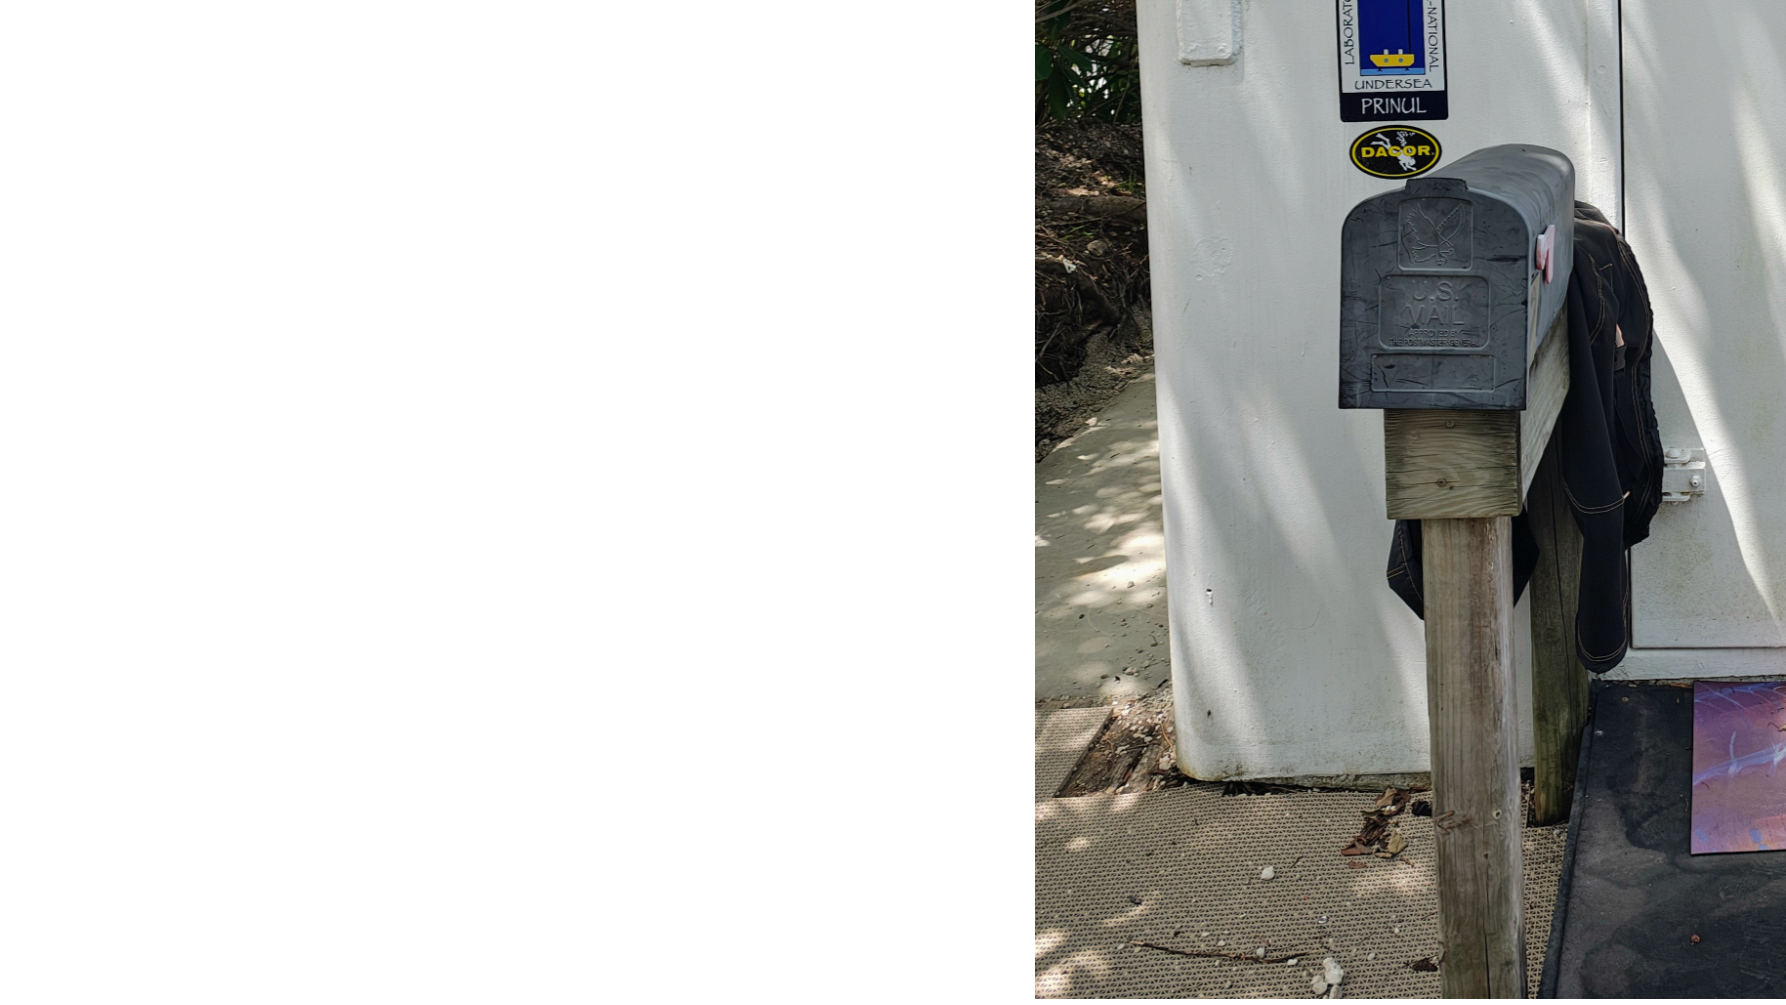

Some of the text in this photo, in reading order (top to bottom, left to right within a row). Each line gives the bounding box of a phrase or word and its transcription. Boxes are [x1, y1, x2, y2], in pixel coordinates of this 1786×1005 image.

[1354, 78, 1433, 91] UNDERSEA
[1361, 97, 1427, 115] PRINUL
[1360, 145, 1431, 158] DACOR
